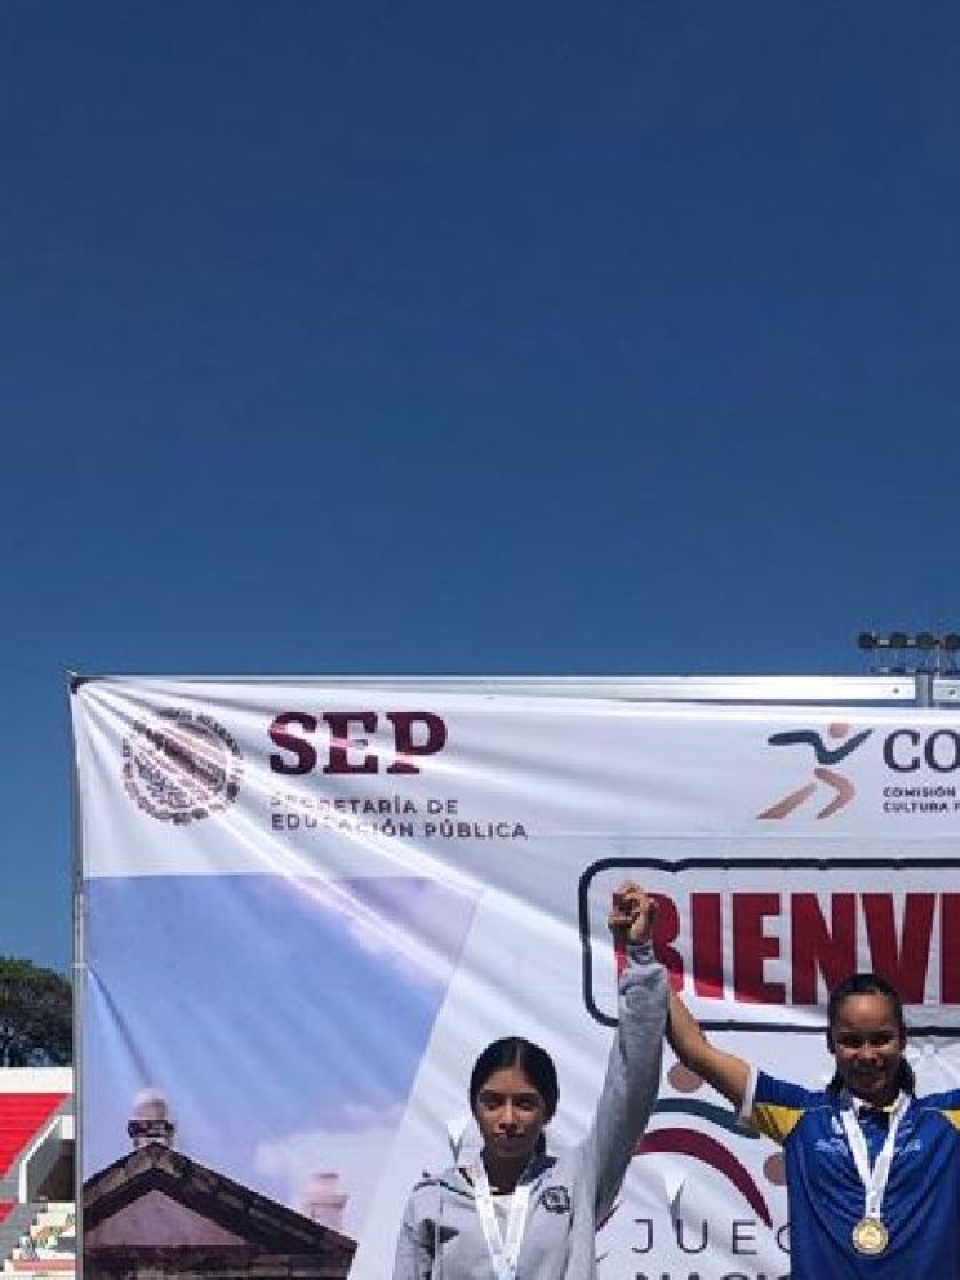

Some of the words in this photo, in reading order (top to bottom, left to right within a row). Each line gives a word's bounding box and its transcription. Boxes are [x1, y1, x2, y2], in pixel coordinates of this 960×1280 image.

[268, 710, 447, 774] SEP
[882, 784, 957, 798] COMISIÓN
[426, 799, 459, 815] DE
[882, 802, 948, 814] CULTURA
[425, 818, 529, 840] PÚBLICA
